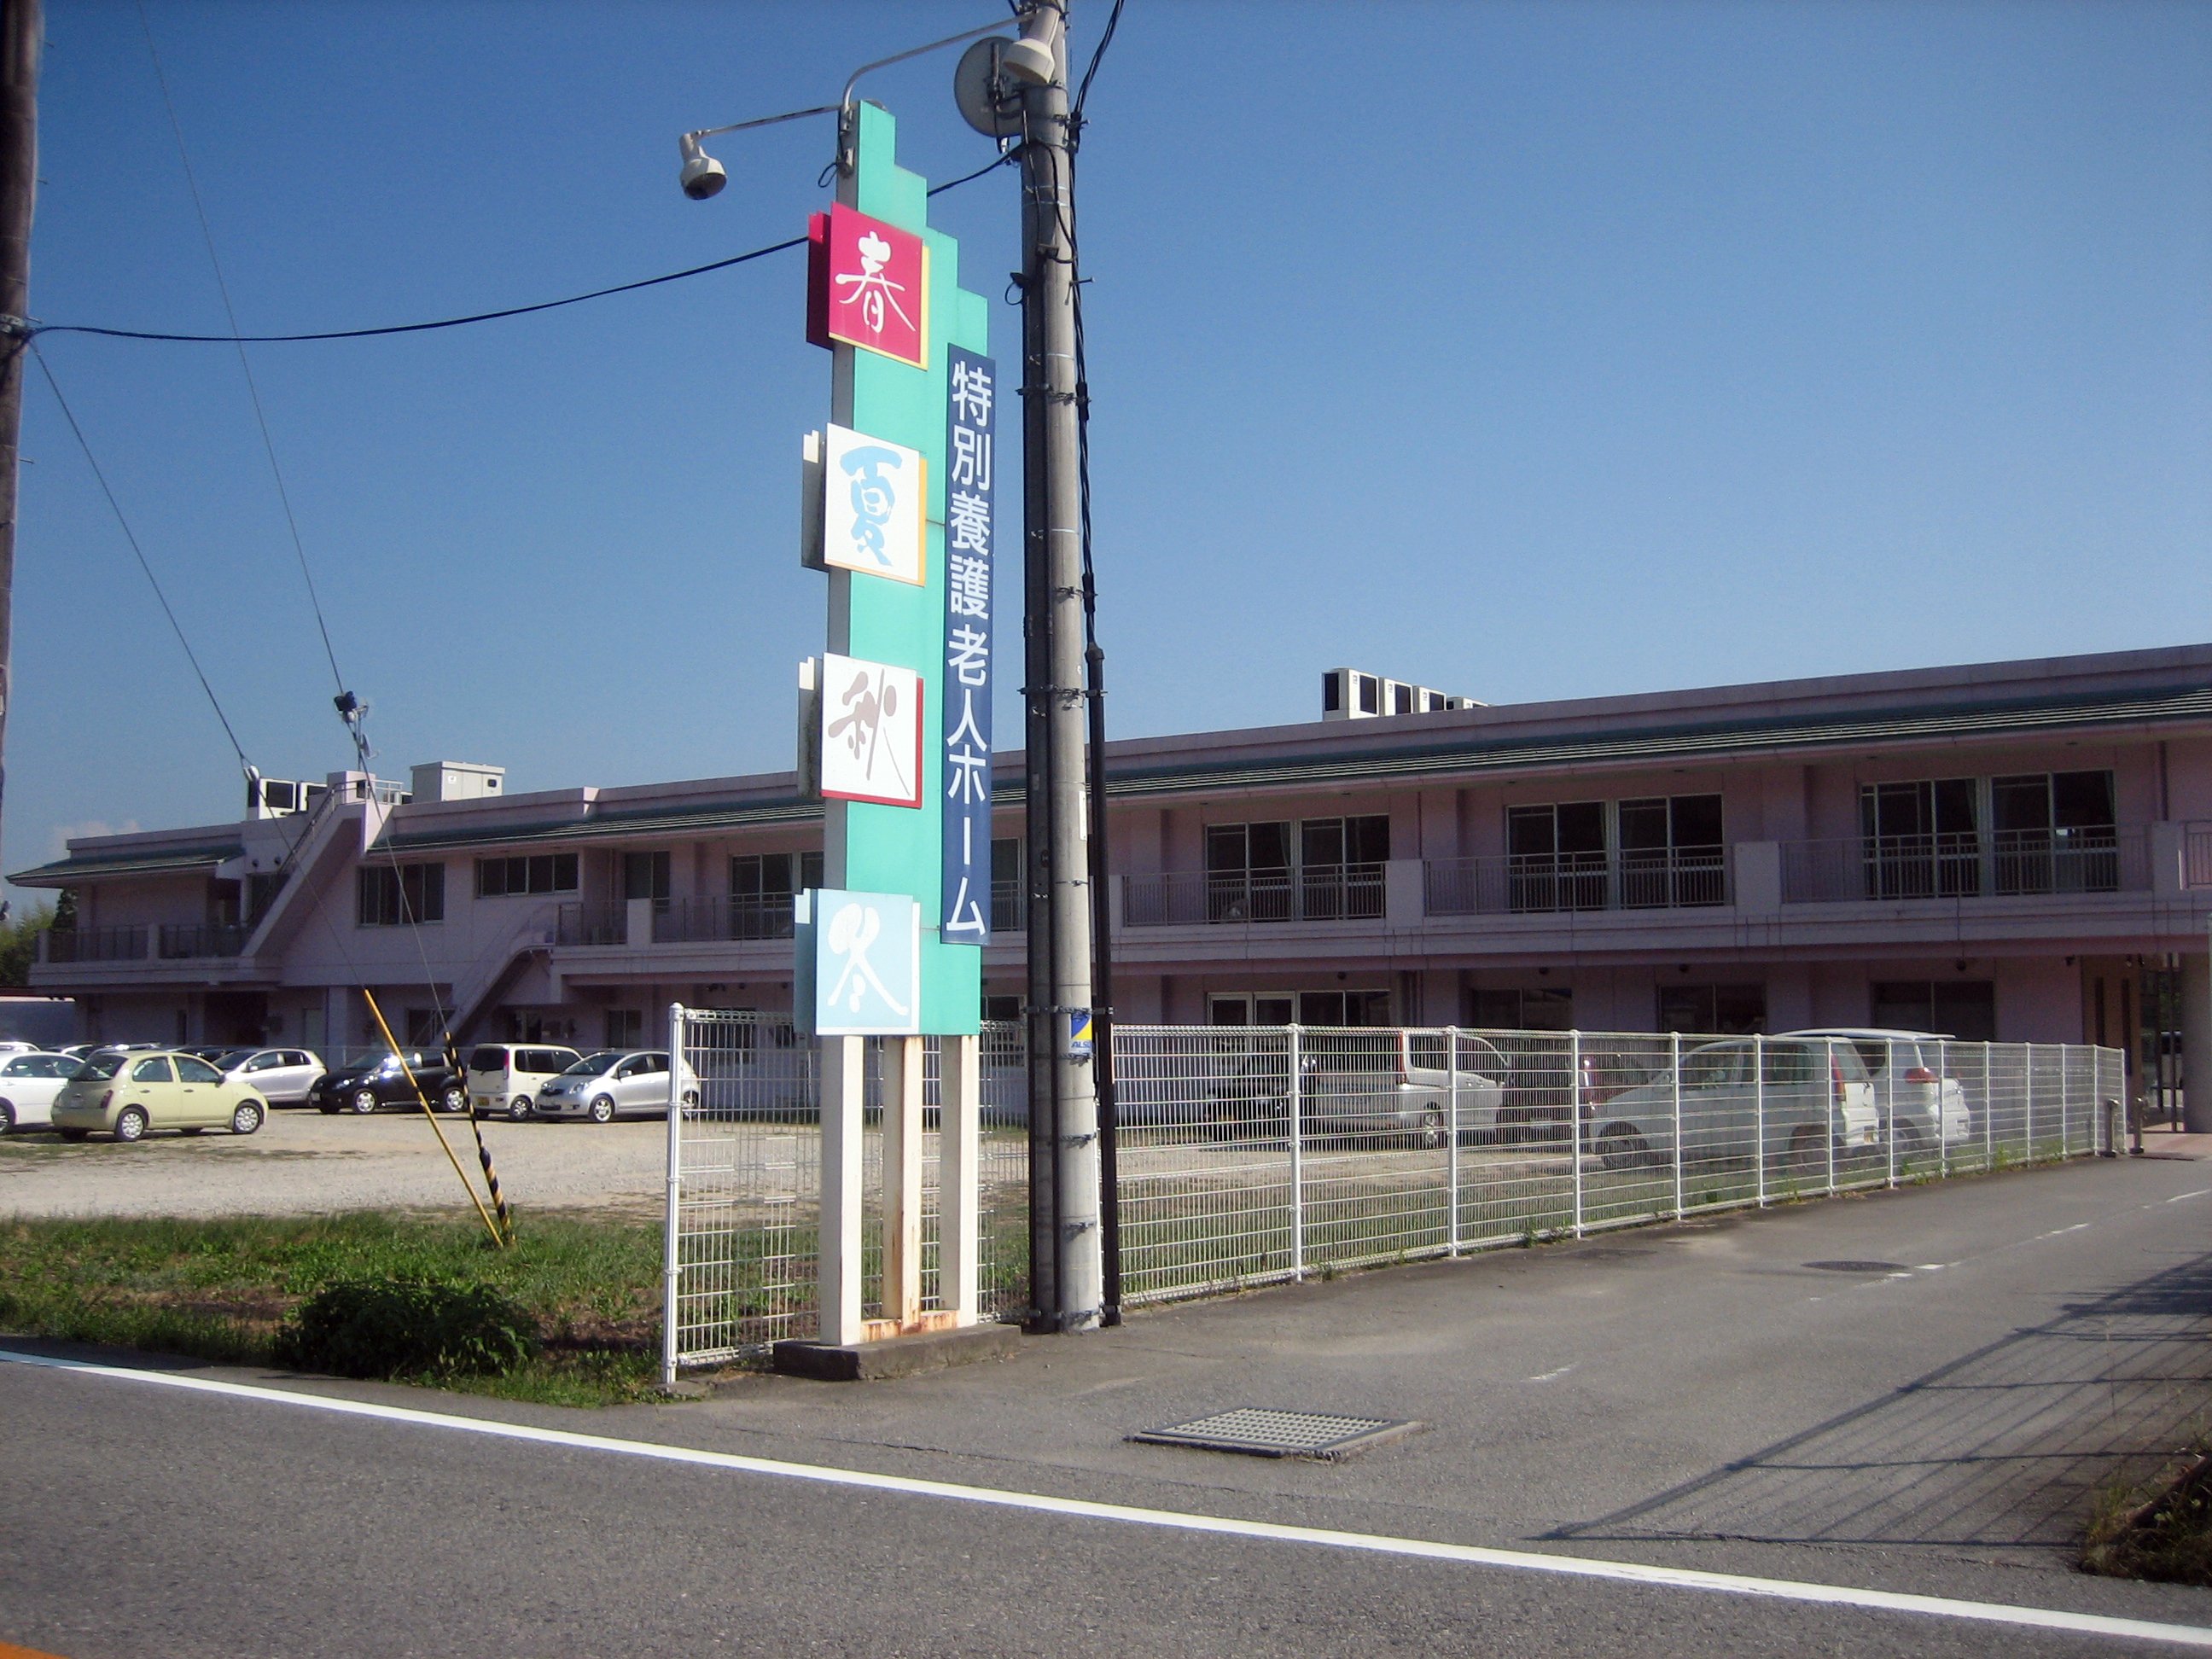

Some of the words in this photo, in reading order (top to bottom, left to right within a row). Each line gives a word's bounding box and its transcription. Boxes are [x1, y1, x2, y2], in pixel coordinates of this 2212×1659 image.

[835, 231, 916, 333] 春
[840, 445, 903, 567] 夏
[946, 360, 992, 935] 特別養護老人ホーム
[828, 668, 911, 796] 秋
[828, 903, 909, 1014] 冬
